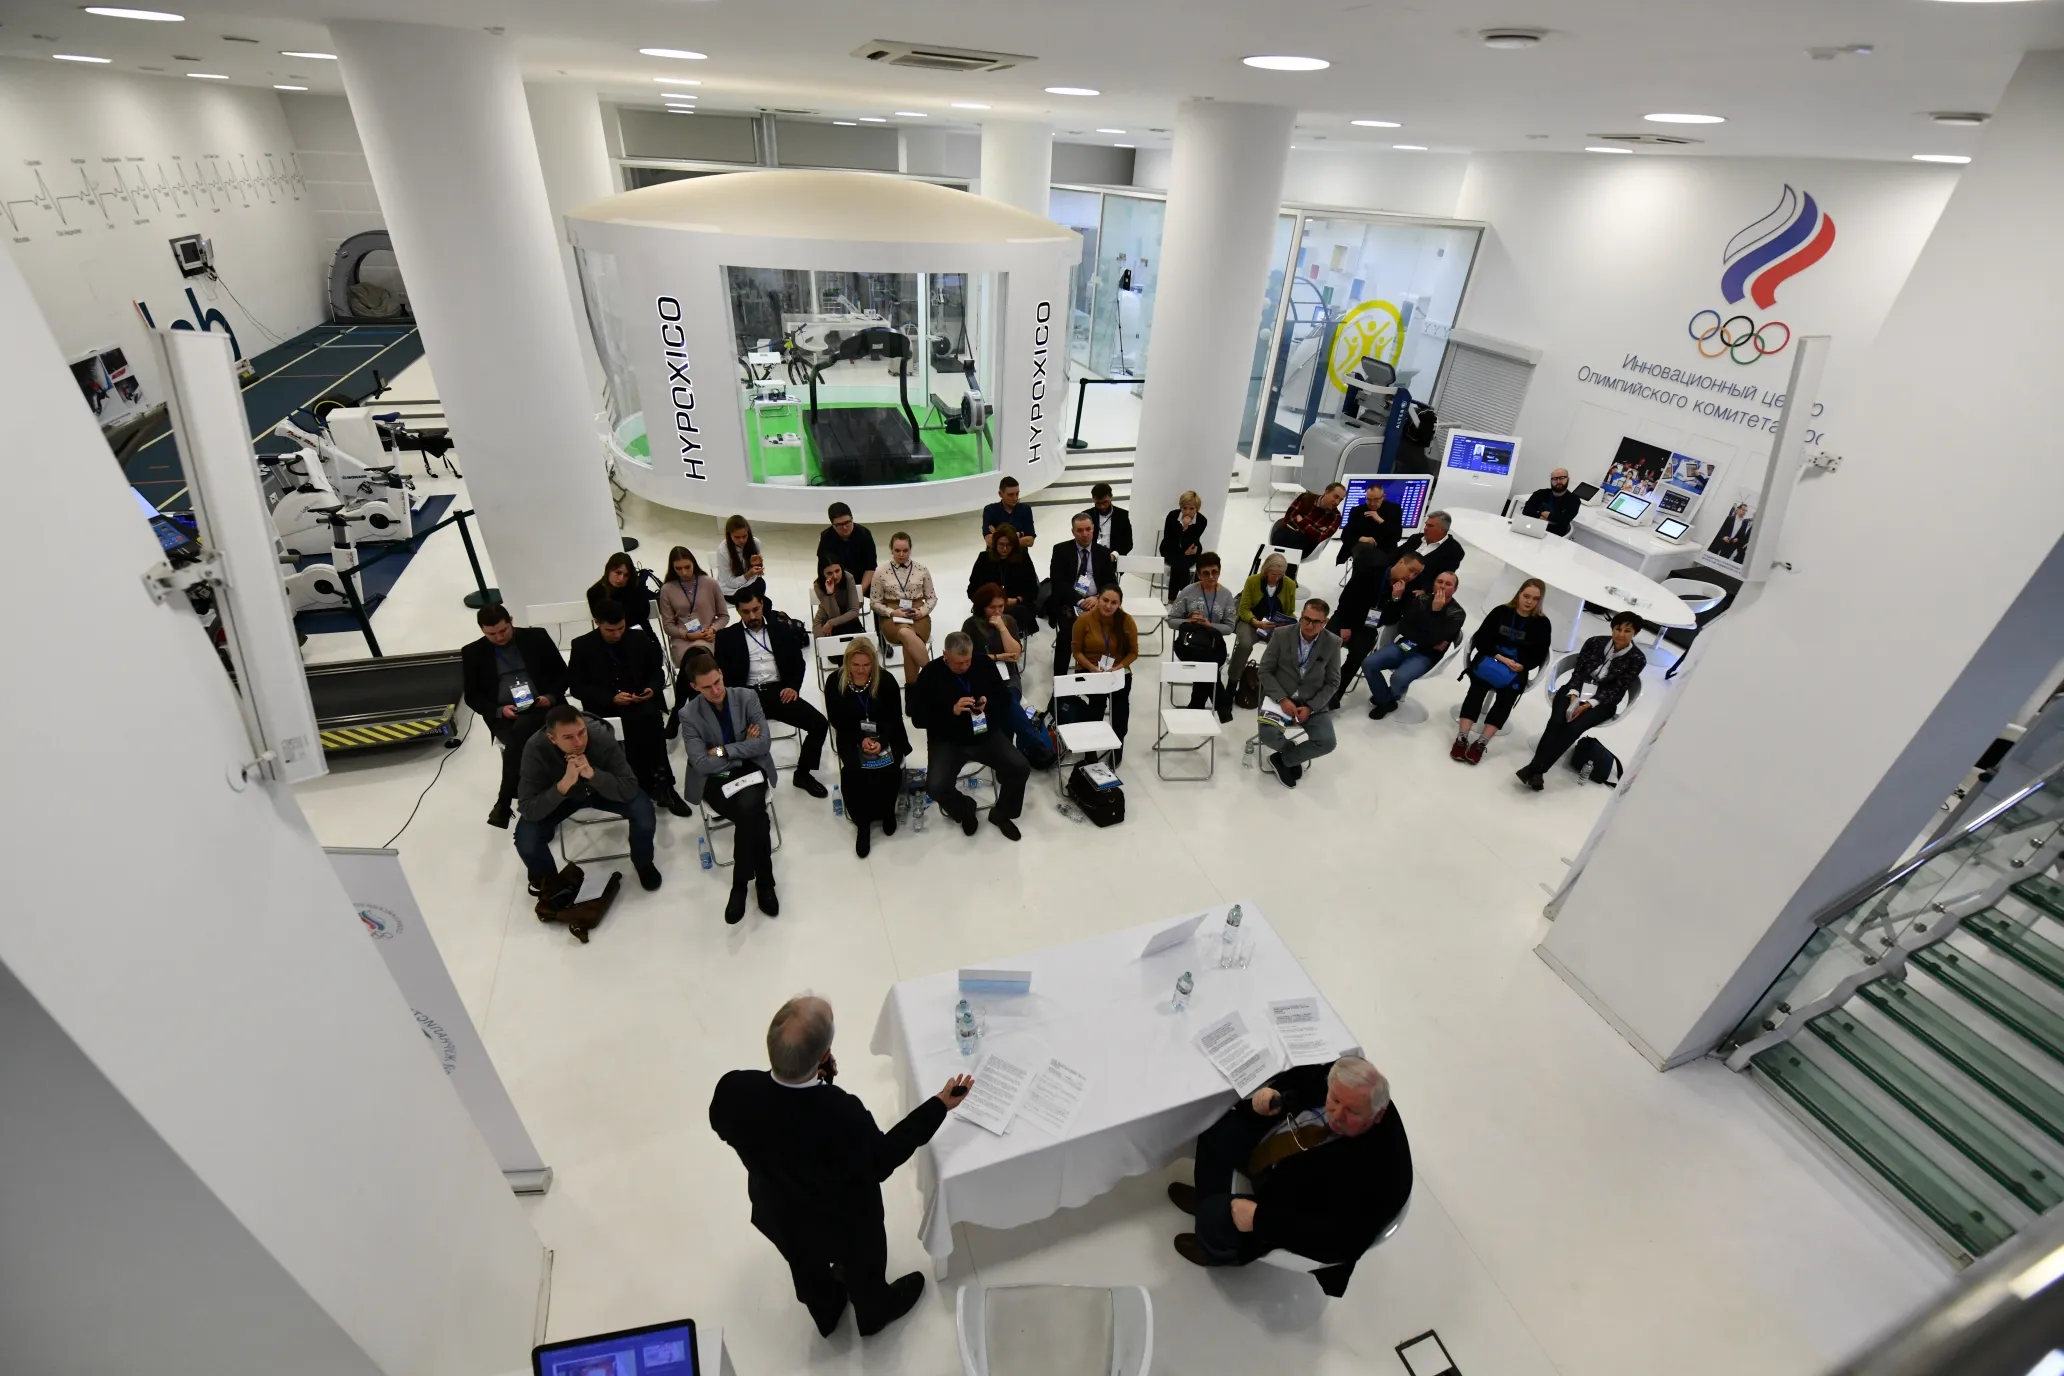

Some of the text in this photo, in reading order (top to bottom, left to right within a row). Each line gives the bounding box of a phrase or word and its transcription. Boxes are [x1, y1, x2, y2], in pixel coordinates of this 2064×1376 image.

[656, 295, 707, 481] HYPOXICO
[1028, 300, 1051, 465] HYPOXICO
[1577, 365, 1688, 409] Олимпийского
[1622, 353, 1758, 401] Инновационный
